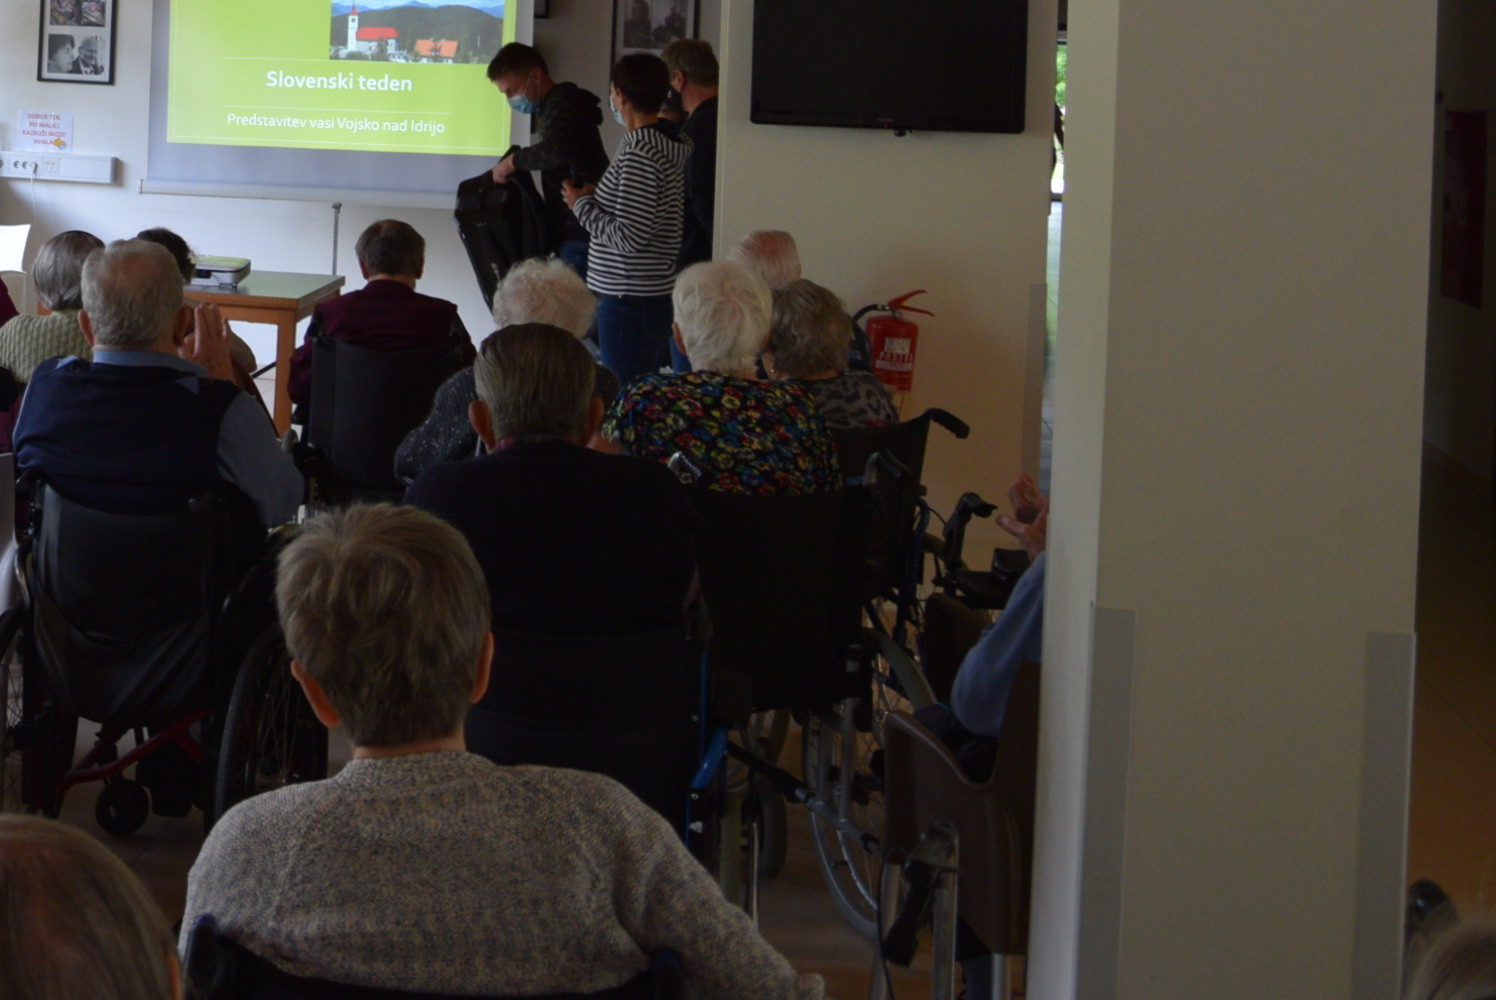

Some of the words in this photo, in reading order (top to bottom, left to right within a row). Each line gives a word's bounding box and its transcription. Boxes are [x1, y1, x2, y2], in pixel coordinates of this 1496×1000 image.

[266, 71, 354, 90] Slovenski
[358, 74, 413, 92] teden
[227, 113, 307, 129] Predstavitev
[309, 117, 335, 130] vasi
[337, 117, 380, 135] Vojsko
[383, 118, 408, 132] nad
[411, 119, 446, 136] Idrijo
